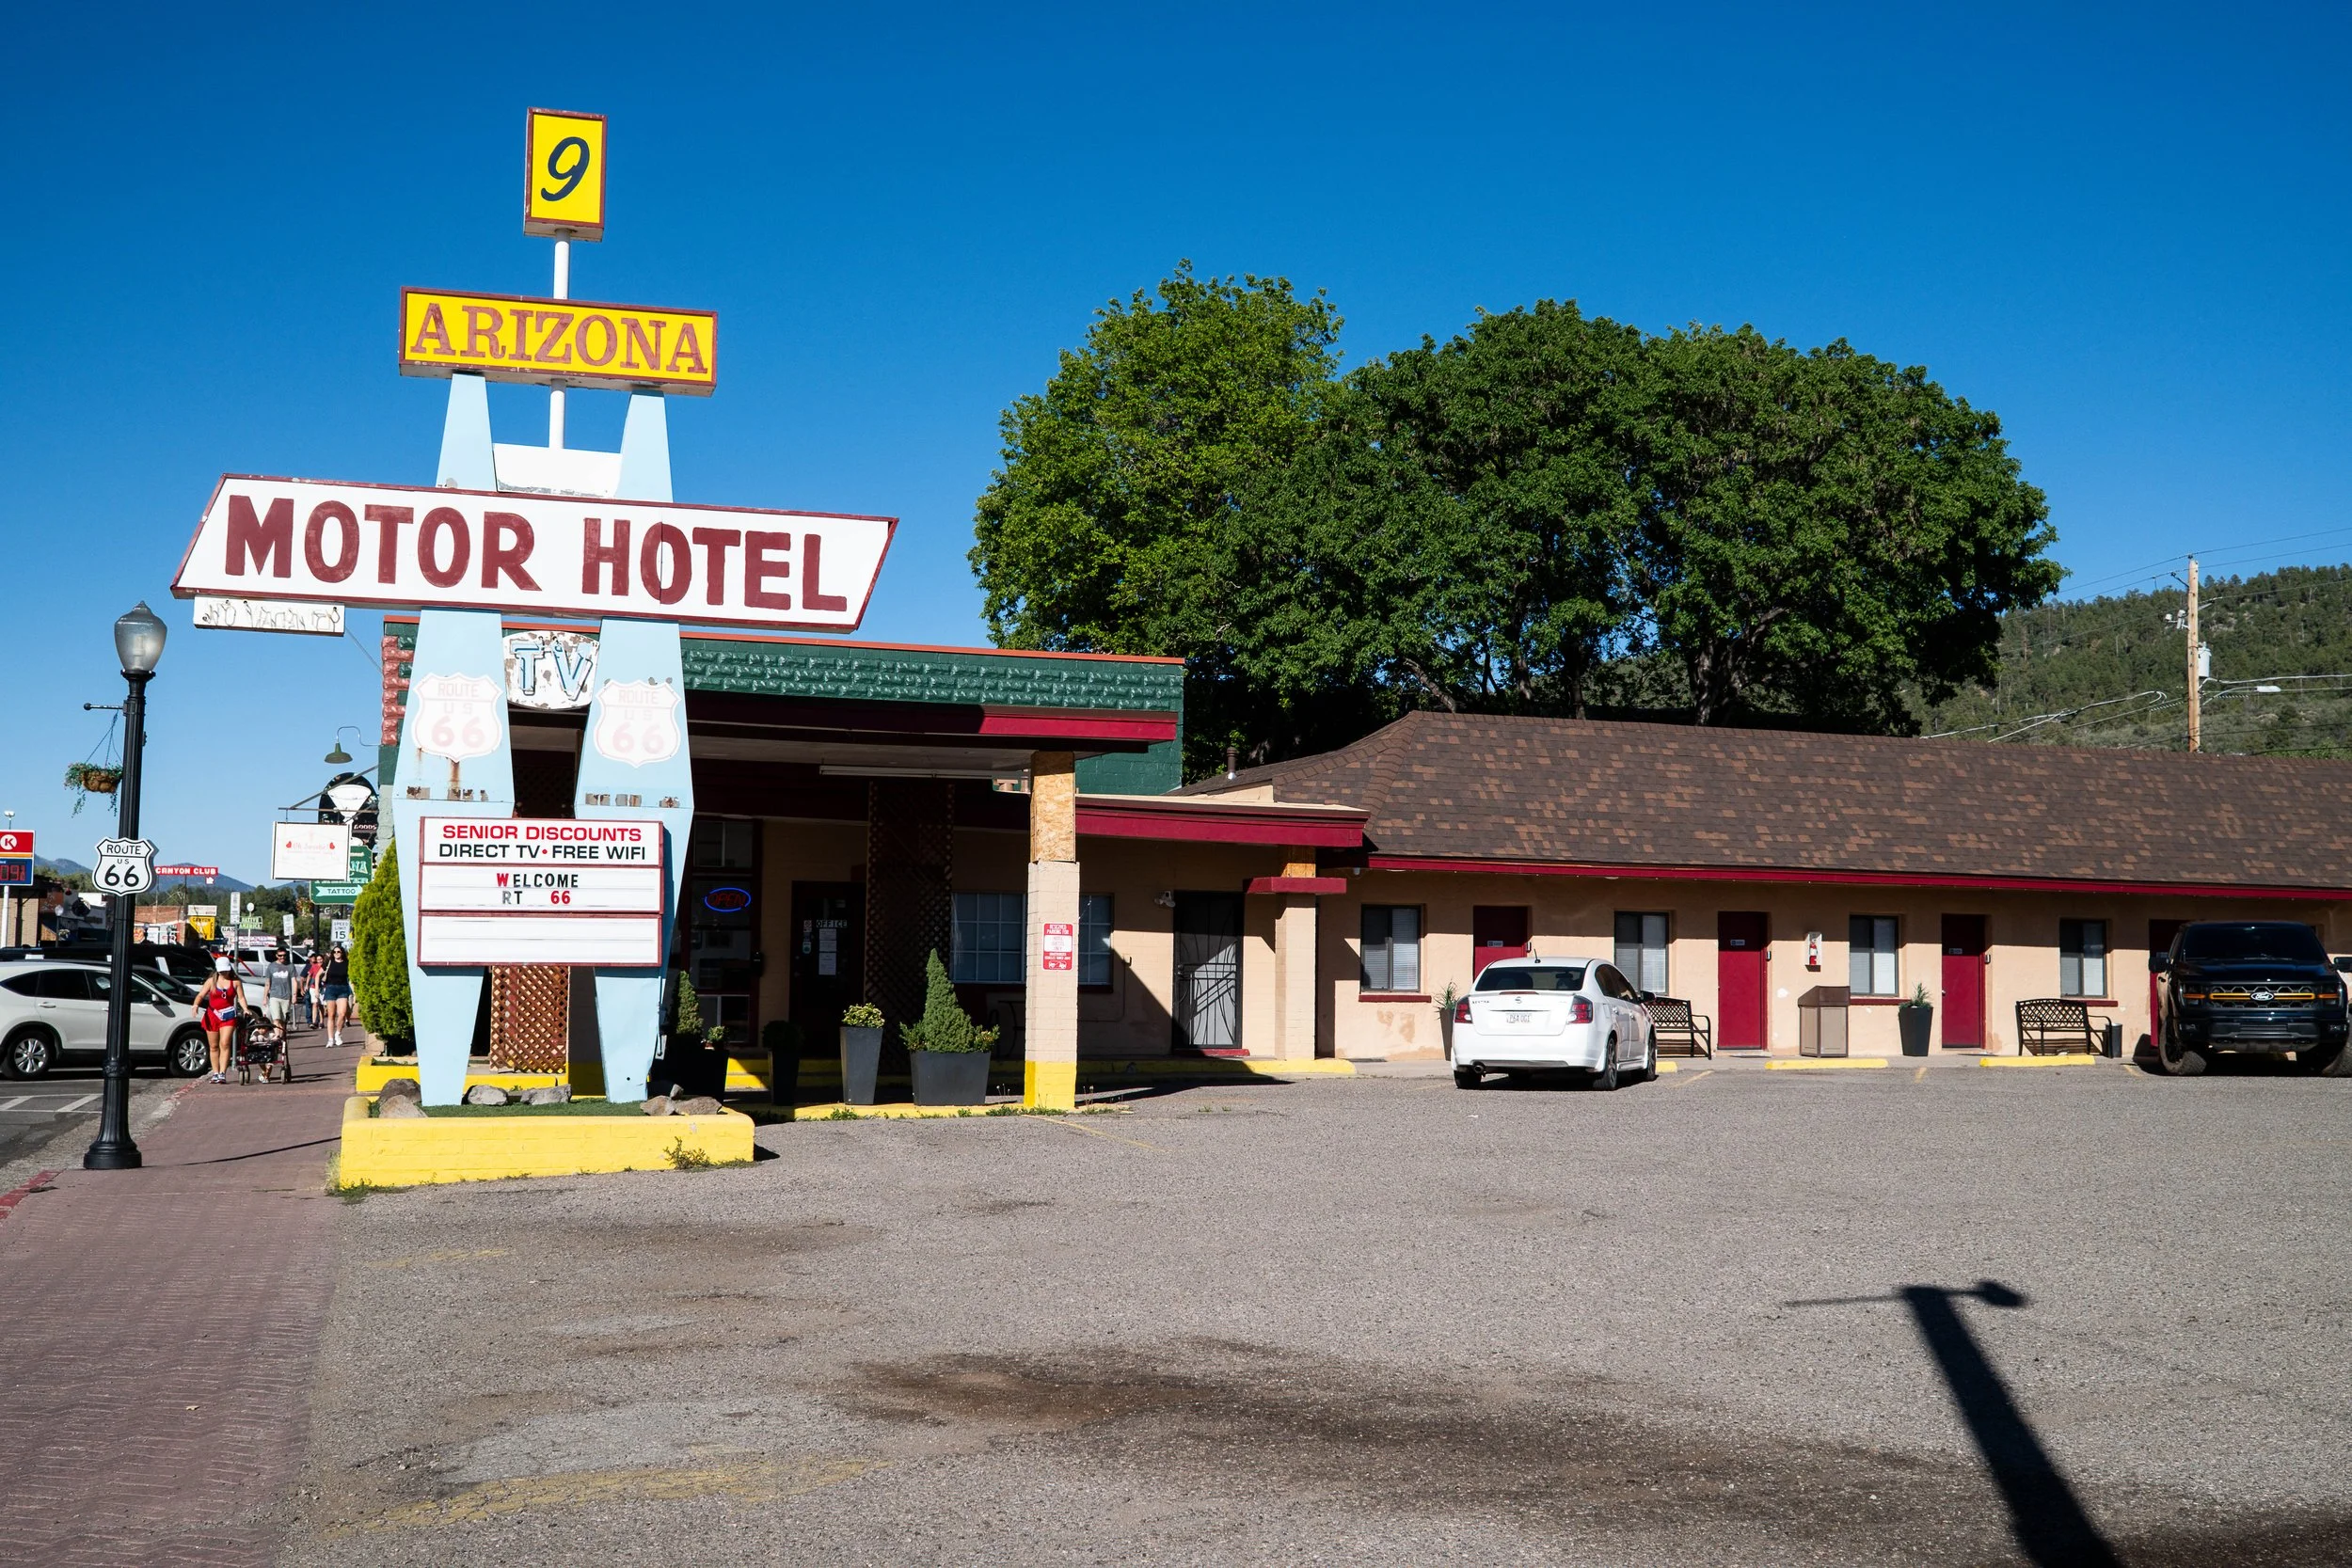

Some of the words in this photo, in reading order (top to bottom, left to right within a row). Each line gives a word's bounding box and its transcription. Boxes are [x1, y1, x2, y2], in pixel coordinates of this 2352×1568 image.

[541, 136, 590, 201] 9
[410, 302, 708, 373] ARIZONA
[225, 494, 543, 592] MOTOR
[581, 517, 848, 612] HOTEL
[511, 641, 594, 702] TV
[437, 682, 480, 698] ROUTE
[618, 689, 660, 705] ROUTE
[431, 715, 486, 748] 66
[612, 721, 664, 754] 66
[442, 825, 518, 840] SENIOR
[526, 826, 642, 842] DISCOUNTS
[106, 845, 141, 854] ROUTE
[438, 843, 510, 858] DIRECT
[516, 844, 540, 859] TV
[552, 845, 599, 860] FREE
[606, 846, 645, 860] WIFI
[104, 864, 139, 887] 66
[497, 873, 579, 889] WELCOME
[502, 891, 523, 905] RT
[550, 890, 571, 905] 66
[707, 892, 746, 907] OPEN
[817, 920, 848, 928] OFFICE
